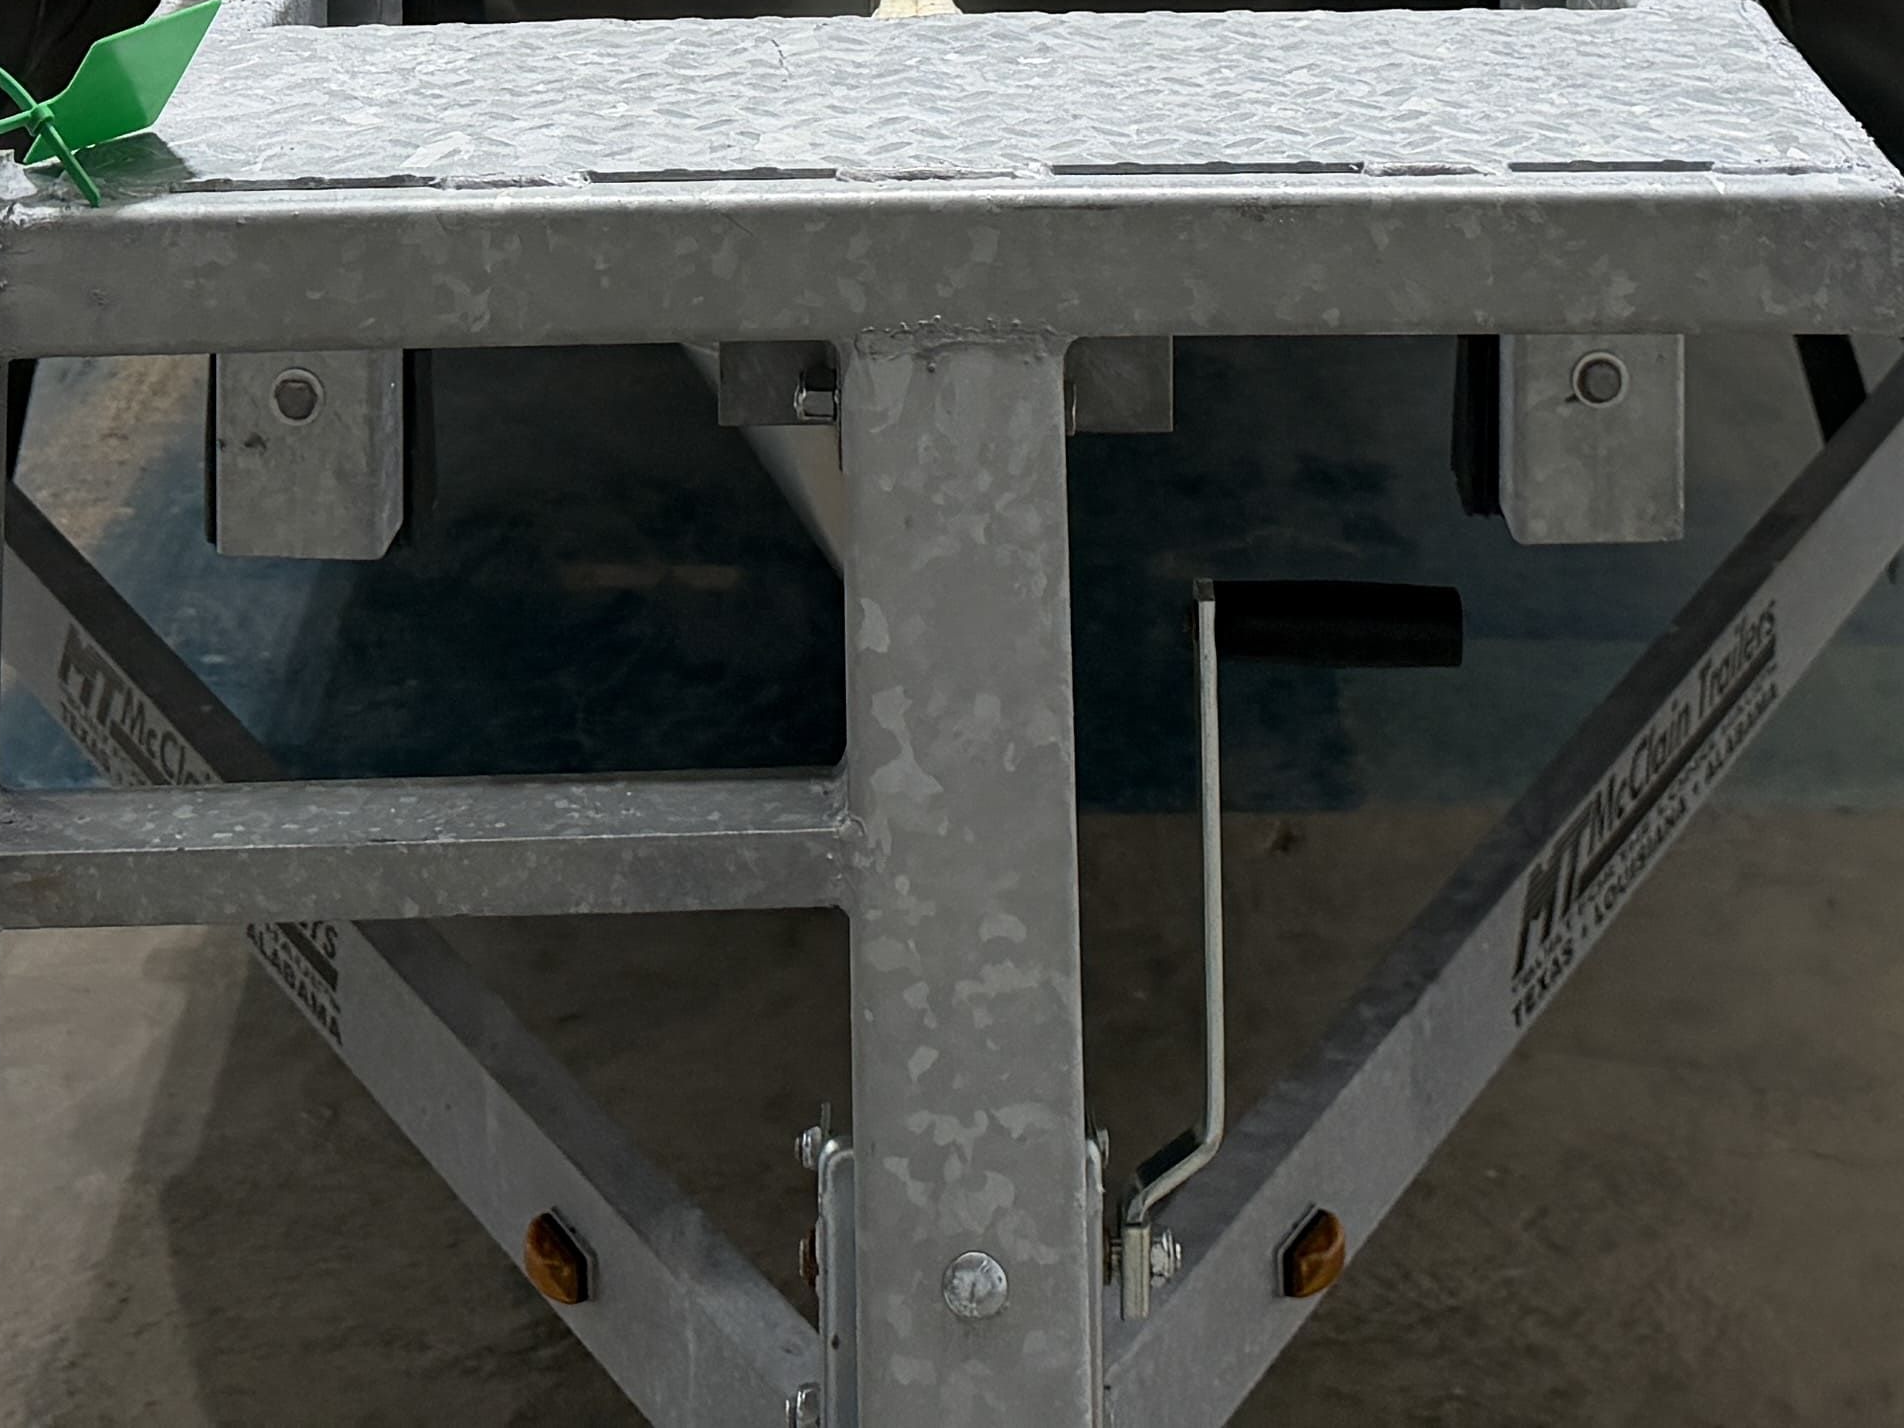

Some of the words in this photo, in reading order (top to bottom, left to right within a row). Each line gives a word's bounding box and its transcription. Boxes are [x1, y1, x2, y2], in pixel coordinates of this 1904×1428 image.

[1512, 937, 1574, 1028] TEXAS
[1594, 794, 1687, 927] LOUISIANA
[1703, 681, 1778, 785] ALABAMA
[1586, 702, 1690, 856] McClain
[1698, 600, 1776, 721] Trailers
